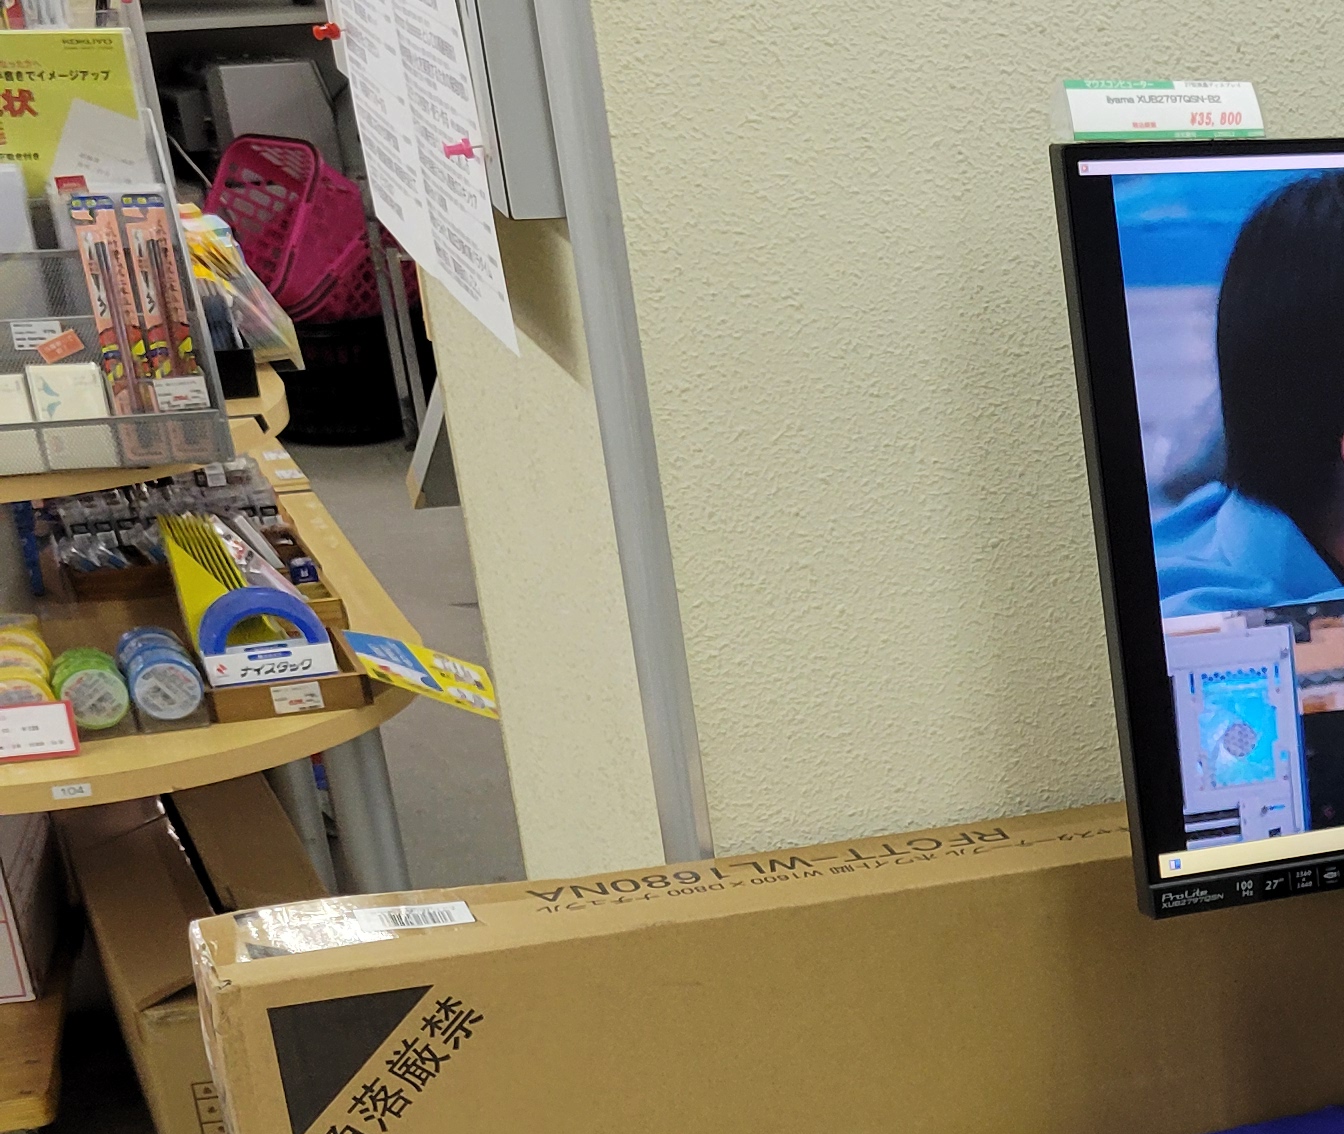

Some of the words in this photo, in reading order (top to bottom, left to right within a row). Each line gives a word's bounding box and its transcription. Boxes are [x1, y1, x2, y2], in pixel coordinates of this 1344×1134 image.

[1084, 80, 1154, 88] マウスコンピューター
[240, 658, 314, 679] ナイスタック
[526, 826, 1010, 904] RFCTT-WL1680NA
[1236, 880, 1253, 891] 100
[1162, 889, 1208, 902] ProLite
